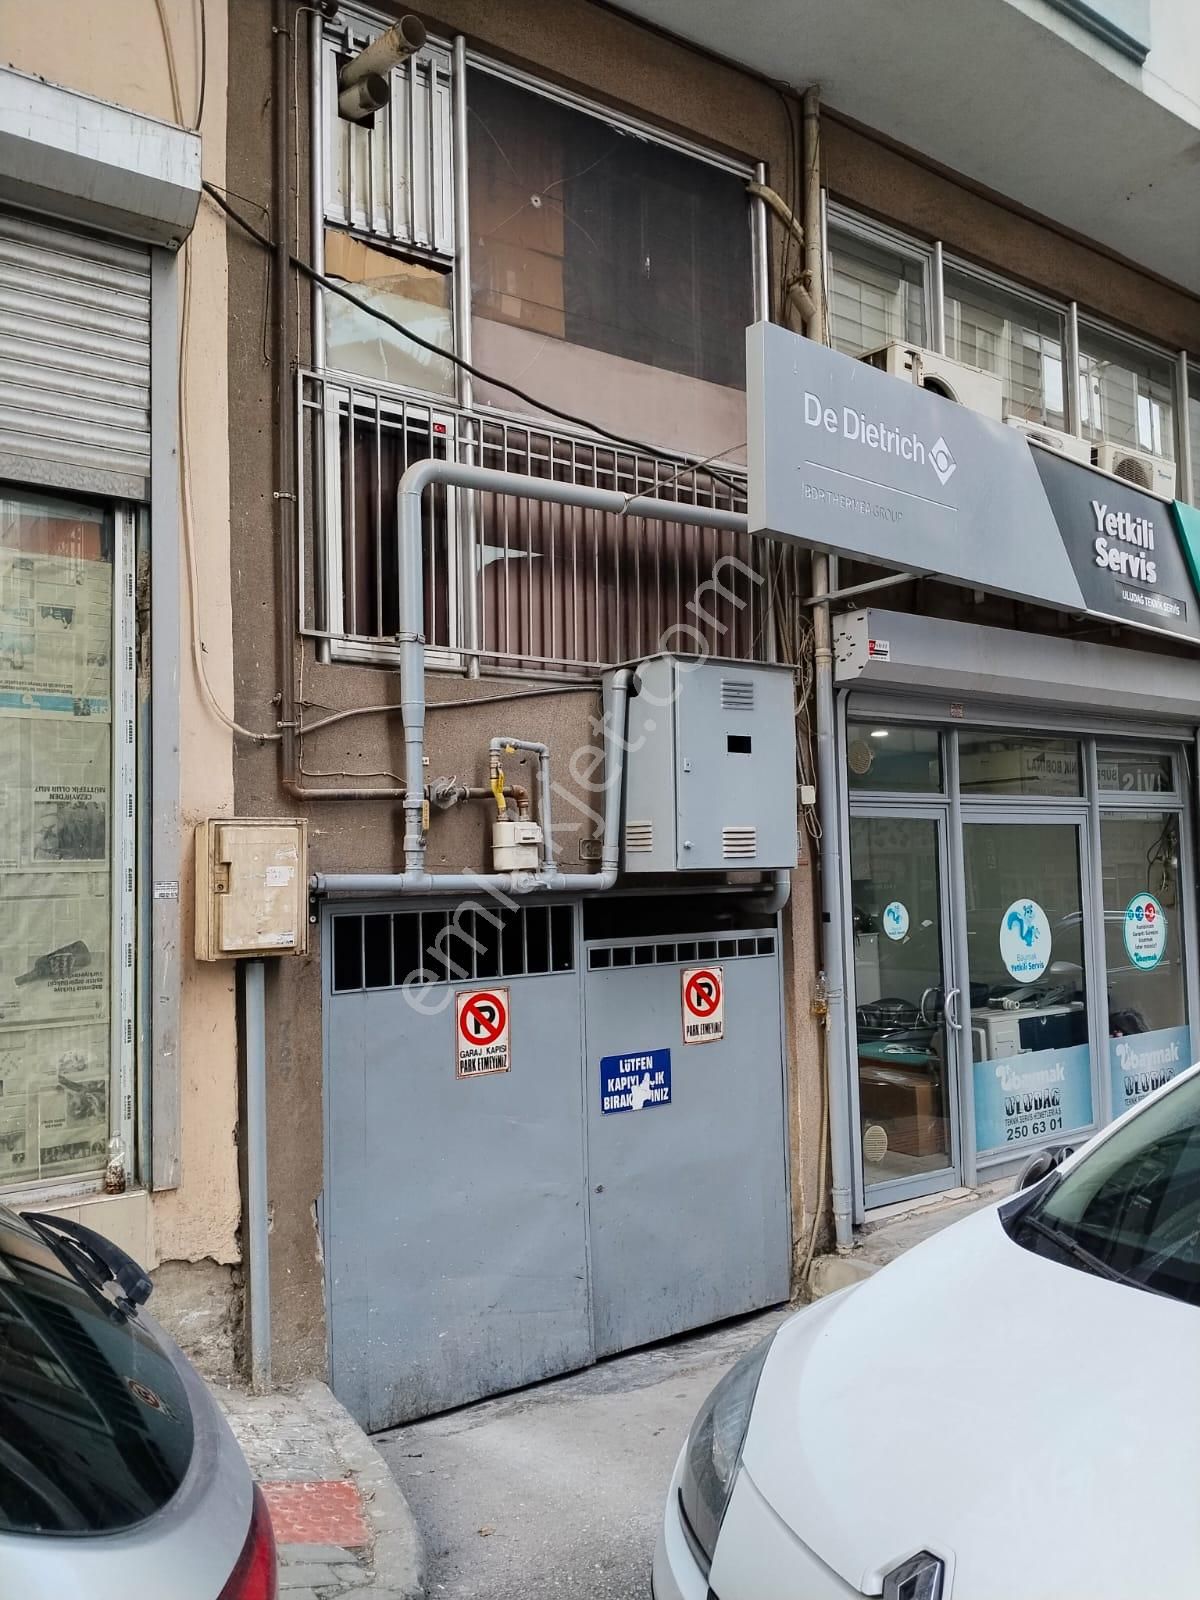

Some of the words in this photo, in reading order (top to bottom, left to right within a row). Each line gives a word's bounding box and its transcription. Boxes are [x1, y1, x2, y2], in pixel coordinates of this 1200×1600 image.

[804, 391, 839, 433] De
[843, 406, 925, 465] Dietrich
[872, 505, 903, 523] GROUP
[1092, 500, 1155, 550] Yetkili
[1095, 537, 1157, 583] Servis
[1028, 961, 1045, 970] Servis
[686, 1024, 700, 1038] PARK
[460, 1048, 483, 1059] GARAJ
[486, 1045, 507, 1055] KAPISI
[1130, 1042, 1180, 1068] baymak
[459, 1056, 477, 1073] PARK
[477, 1053, 508, 1071] ETMEYİNİZ
[619, 1056, 653, 1073] LÜTFEN
[608, 1075, 640, 1092] KAPIYI
[1006, 1126, 1029, 1141] 250
[1032, 1121, 1046, 1135] 63
[1050, 1117, 1063, 1131] 01
